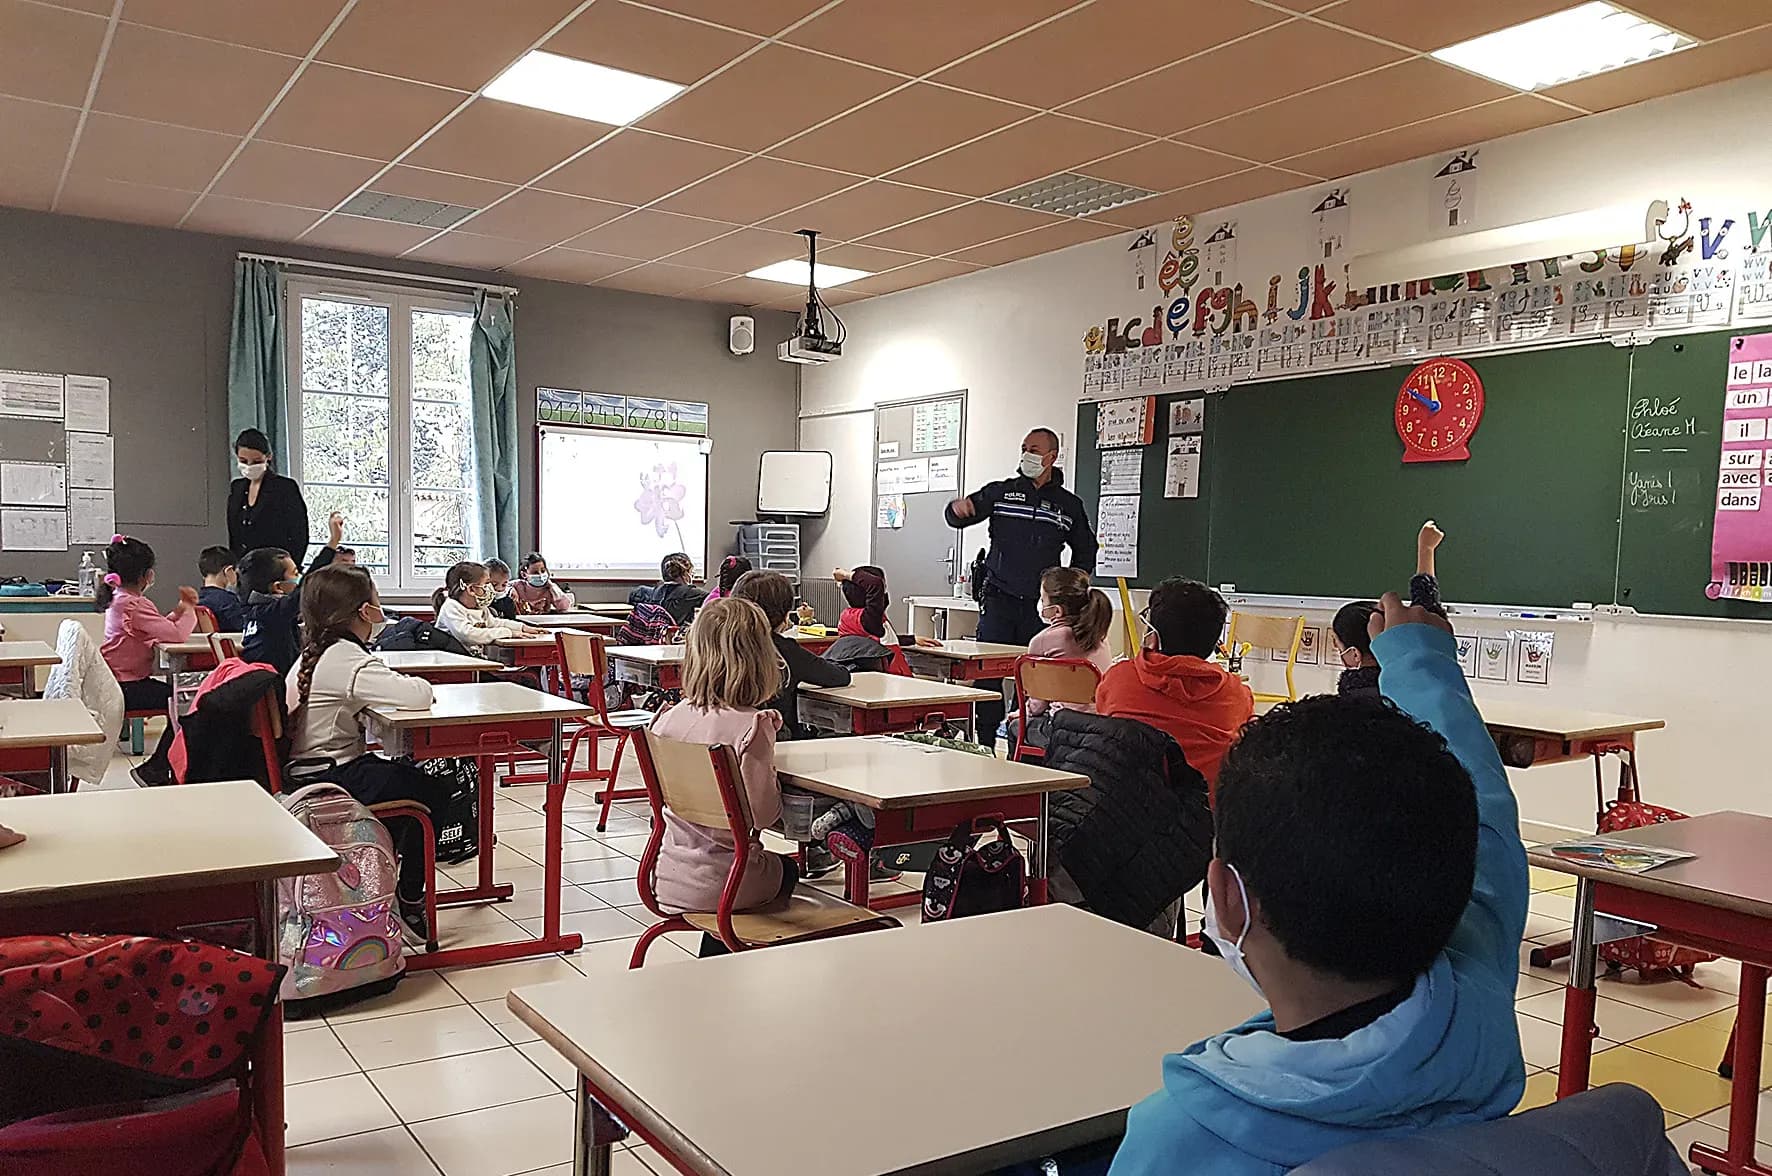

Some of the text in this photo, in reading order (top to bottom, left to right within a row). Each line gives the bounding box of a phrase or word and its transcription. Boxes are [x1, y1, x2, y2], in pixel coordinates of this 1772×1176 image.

[1433, 366, 1445, 378] 12
[1451, 371, 1457, 382] 1
[1734, 364, 1772, 380] le la
[1417, 374, 1428, 386] 11
[1462, 383, 1470, 394] 2
[1737, 393, 1757, 404] un
[1402, 404, 1409, 415] 9
[1466, 399, 1473, 410] 3
[1631, 397, 1680, 419] Chloé
[1406, 421, 1413, 433] 8
[1459, 417, 1466, 429] 4
[1740, 423, 1749, 437] il
[1417, 433, 1424, 444] 7
[1431, 436, 1438, 447] 6
[1447, 431, 1453, 441] 5
[1728, 454, 1755, 465] sur
[1722, 473, 1757, 484] avec
[1721, 492, 1757, 506] dans
[443, 828, 461, 839] SELF
